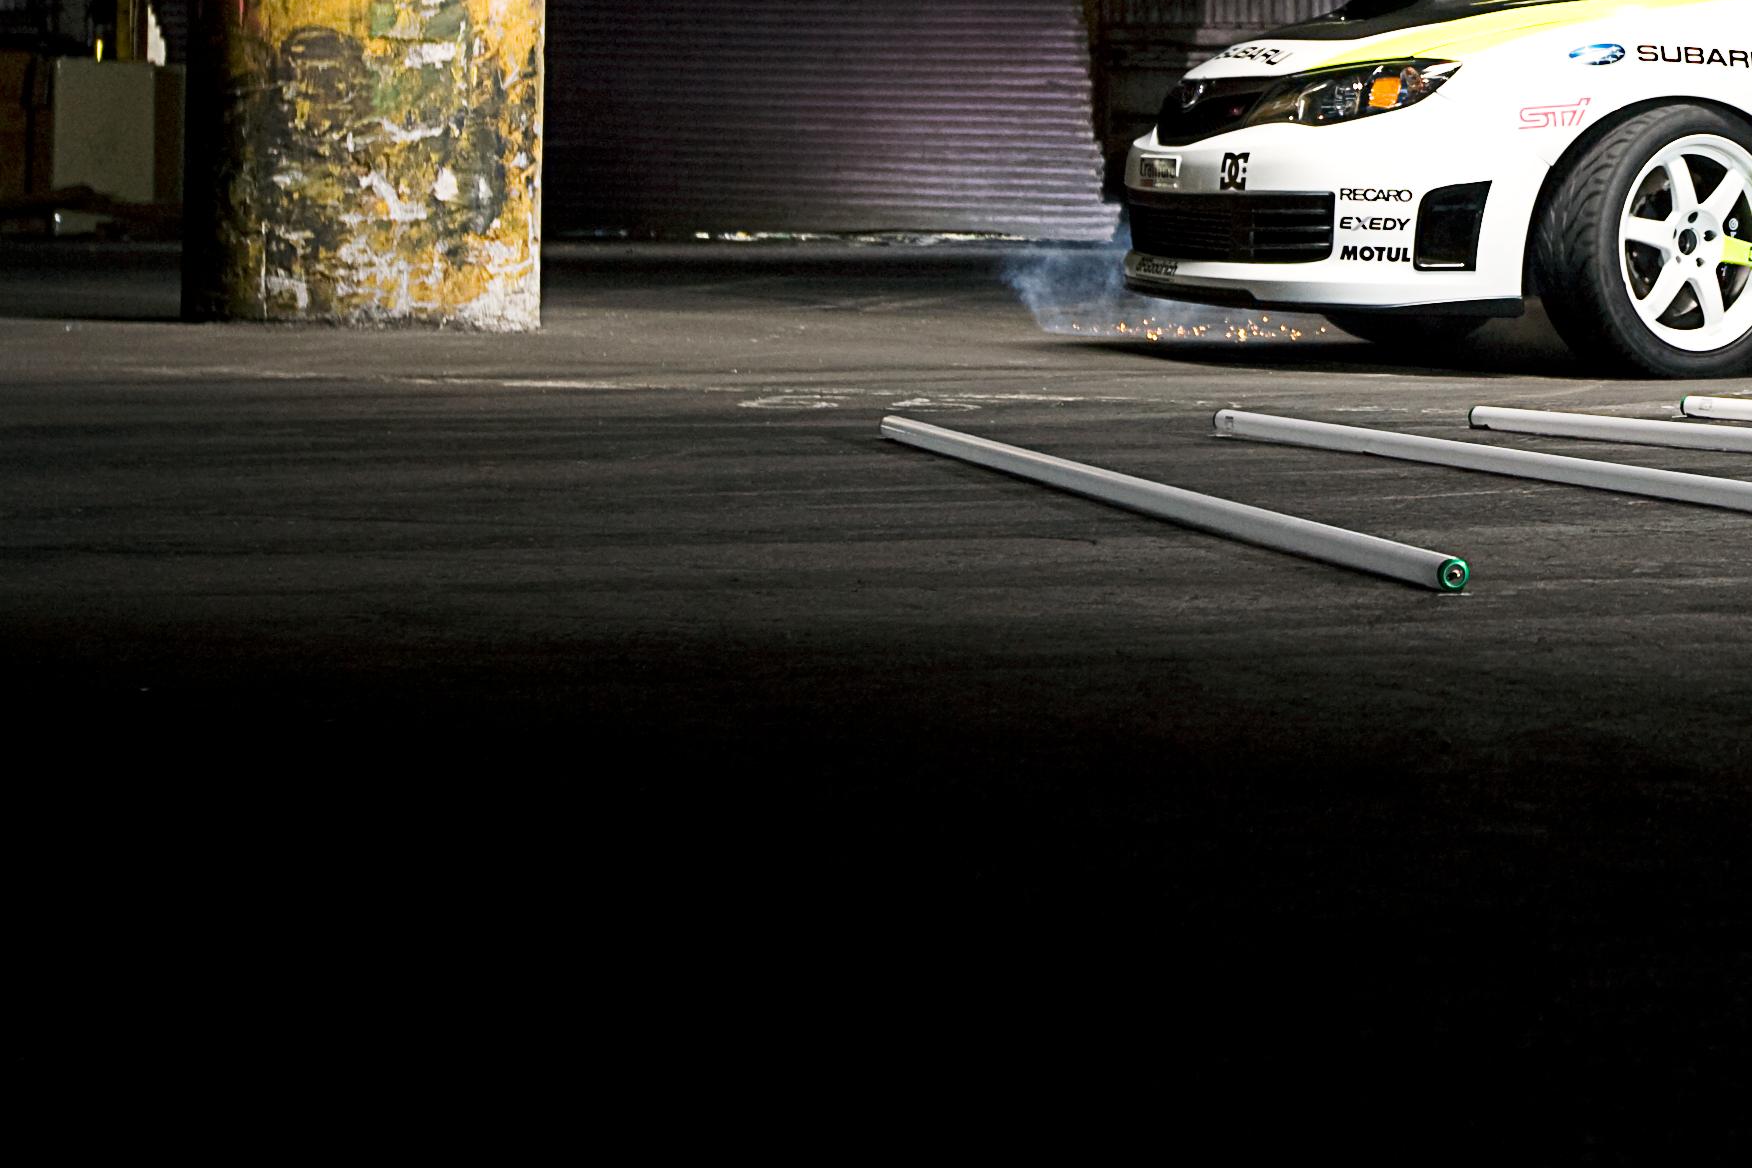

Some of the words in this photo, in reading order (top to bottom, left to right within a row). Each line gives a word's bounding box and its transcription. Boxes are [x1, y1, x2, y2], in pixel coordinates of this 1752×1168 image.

[1219, 152, 1250, 190] DC
[1339, 188, 1413, 203] RECARO
[1339, 216, 1411, 232] EXEDY
[1339, 245, 1411, 263] MOTUL
